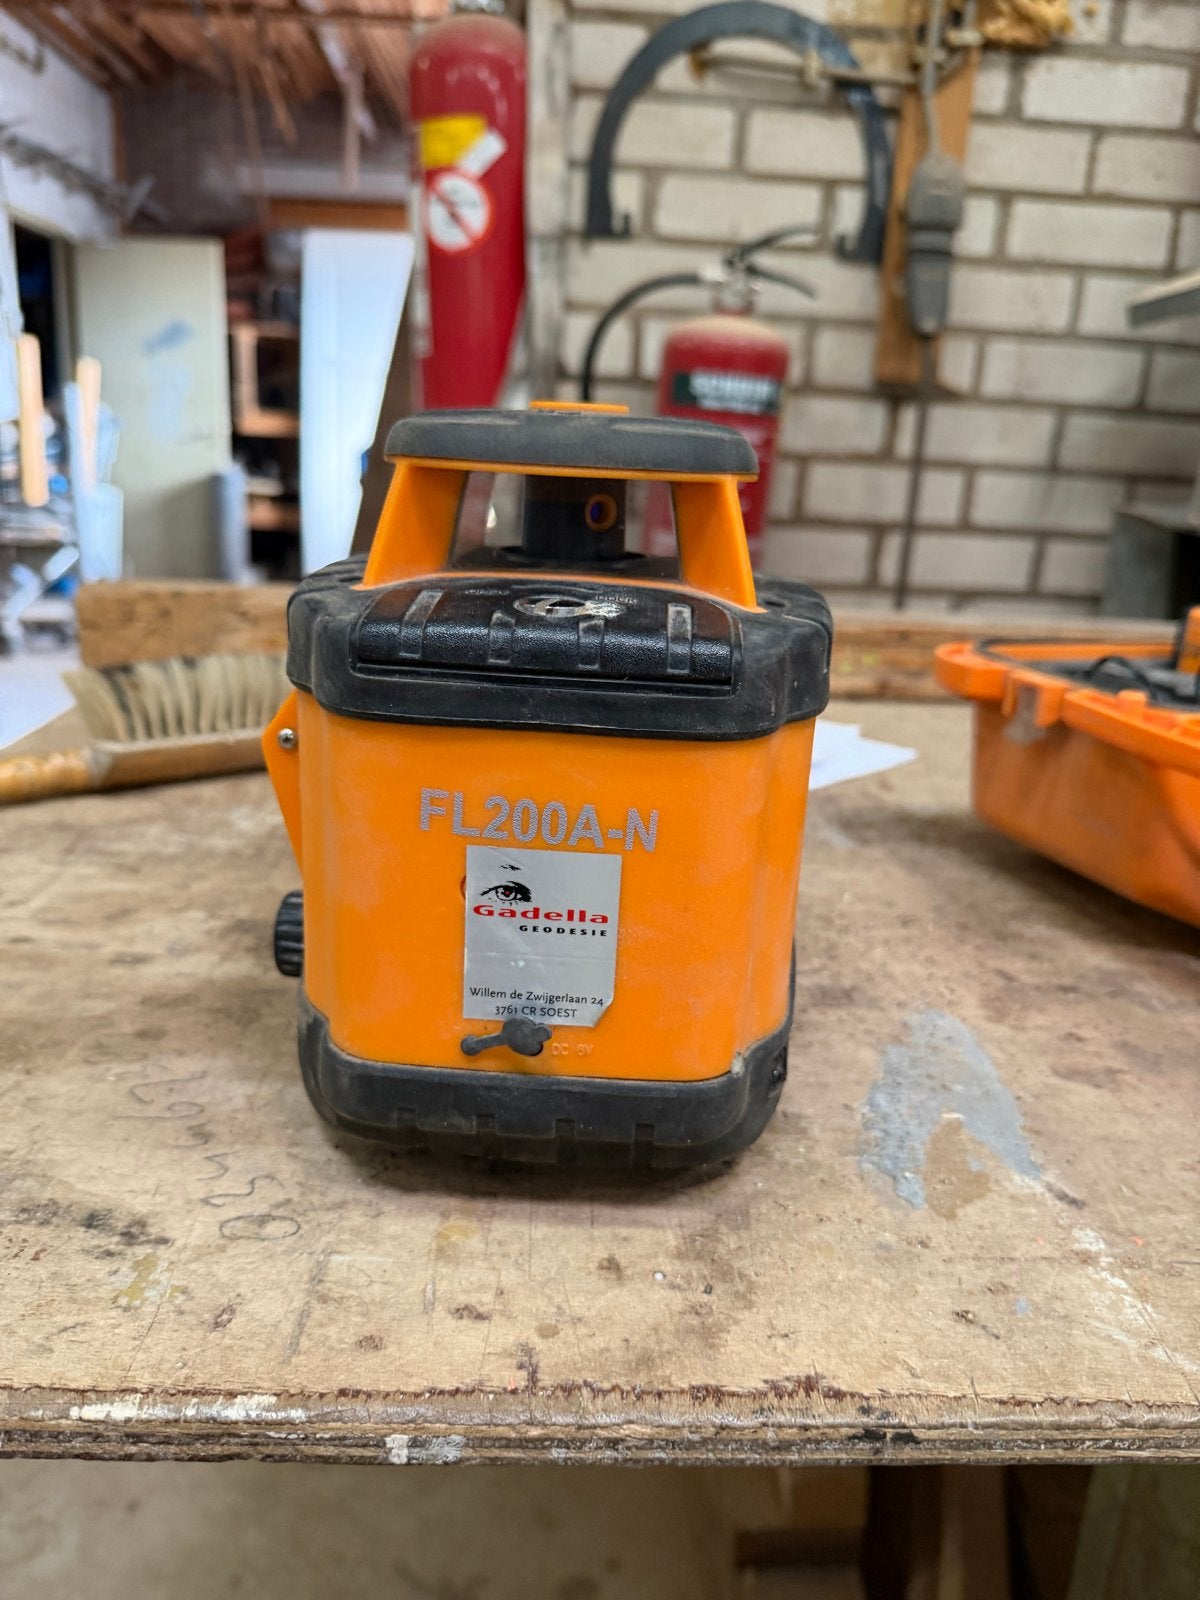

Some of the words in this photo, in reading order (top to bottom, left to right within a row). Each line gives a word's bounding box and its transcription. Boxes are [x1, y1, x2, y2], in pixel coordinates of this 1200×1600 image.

[420, 787, 659, 852] FL200A-N
[473, 904, 609, 924] Gadella
[519, 925, 608, 937] GEODESIE
[469, 986, 507, 998] Willem
[510, 989, 524, 1000] de
[526, 991, 588, 1005] Zwijgerlaan
[591, 998, 604, 1007] 24
[495, 1004, 518, 1016] 3761
[521, 1006, 537, 1016] CR
[540, 1007, 578, 1018] SOEST
[552, 1042, 569, 1056] DC
